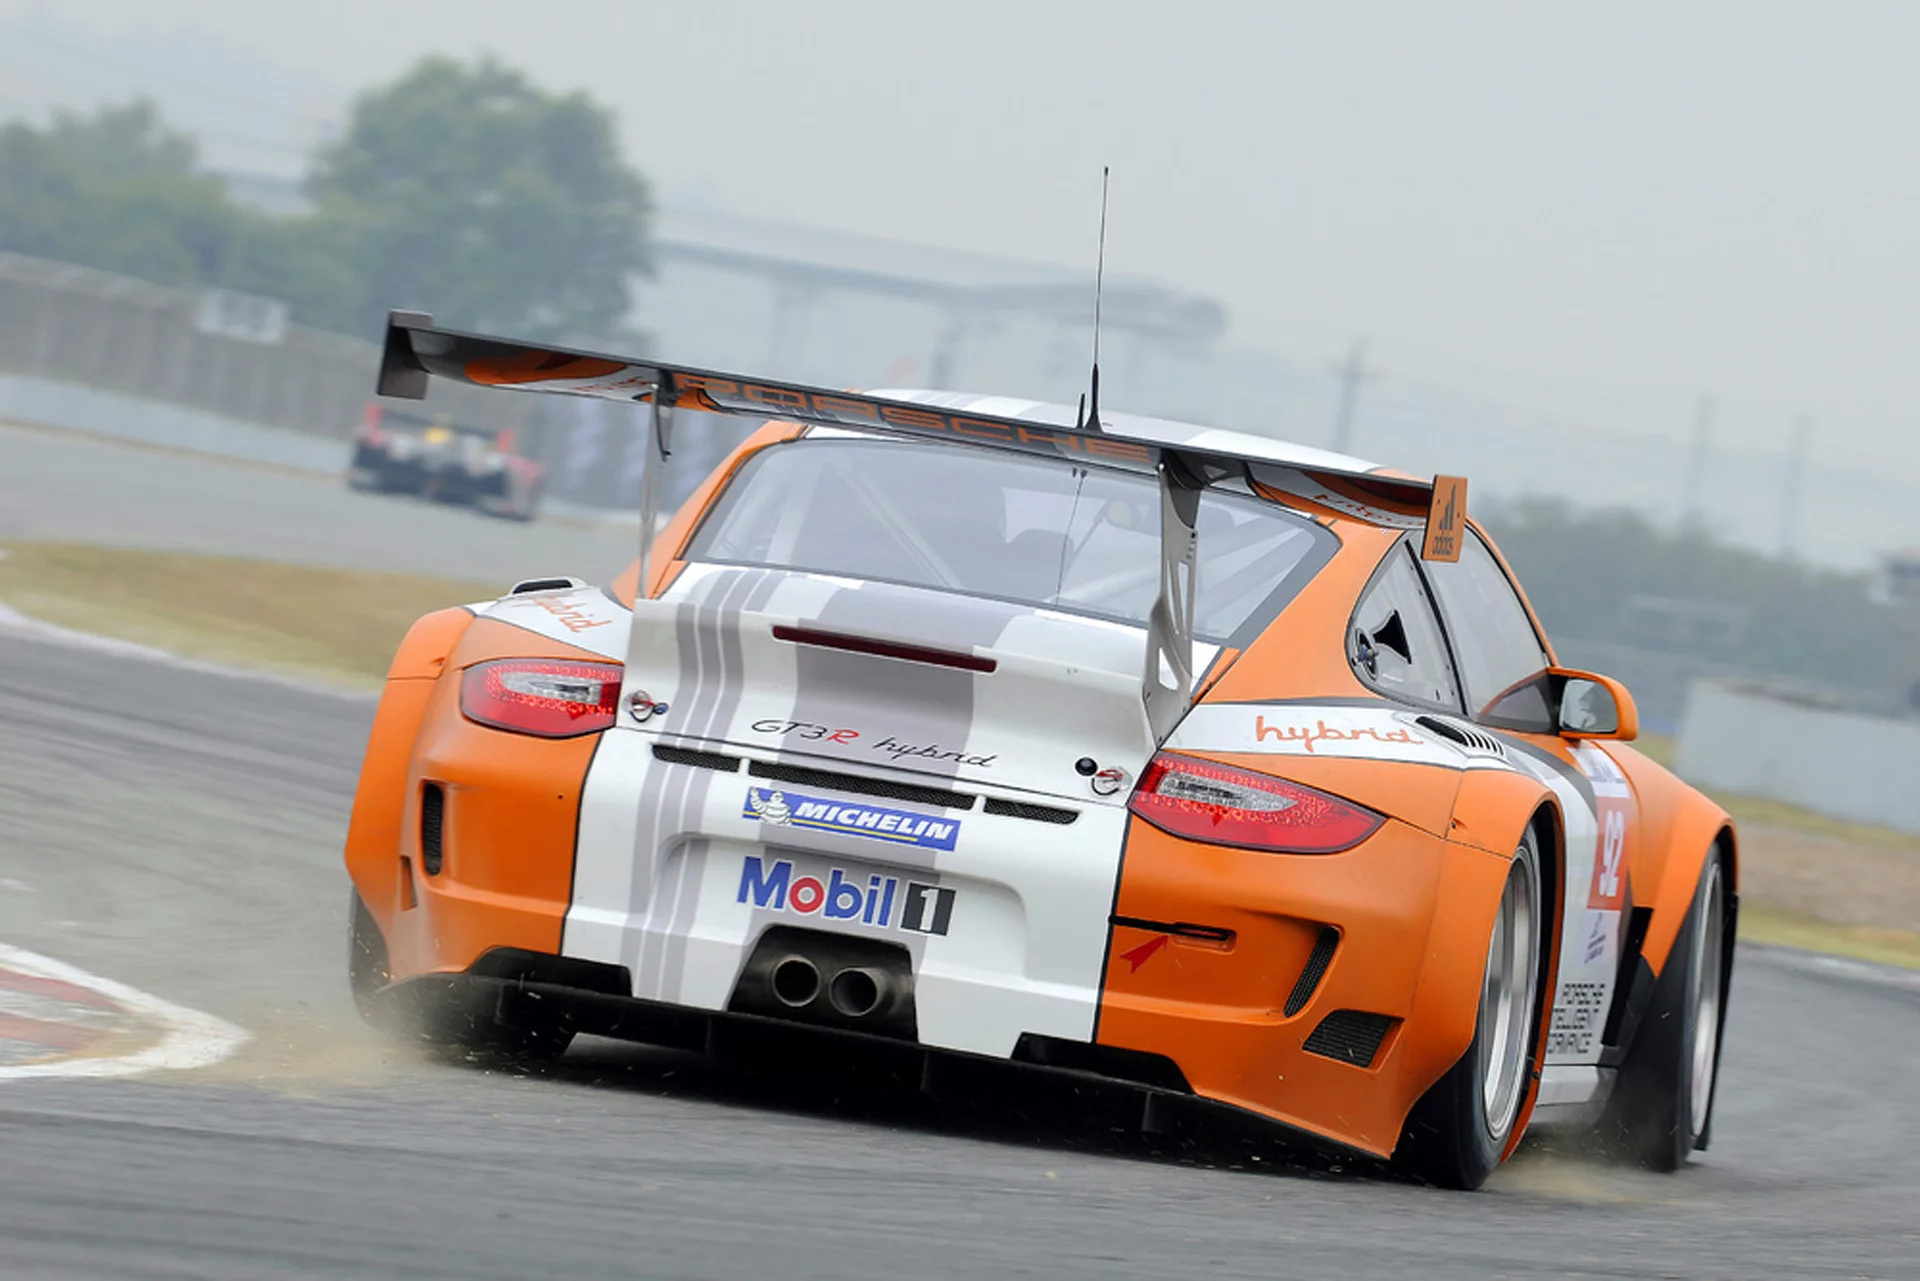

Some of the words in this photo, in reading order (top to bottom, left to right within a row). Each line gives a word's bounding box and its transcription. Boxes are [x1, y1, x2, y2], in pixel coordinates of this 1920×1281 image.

[672, 371, 1150, 463] PORSCHE
[508, 595, 613, 633] ybrid
[751, 719, 860, 745] GT3R
[872, 736, 998, 768] hybrid
[1255, 715, 1424, 753] hybrid
[794, 801, 954, 840] MICHELIN
[1599, 809, 1625, 897] 92
[736, 855, 898, 927] Mobil
